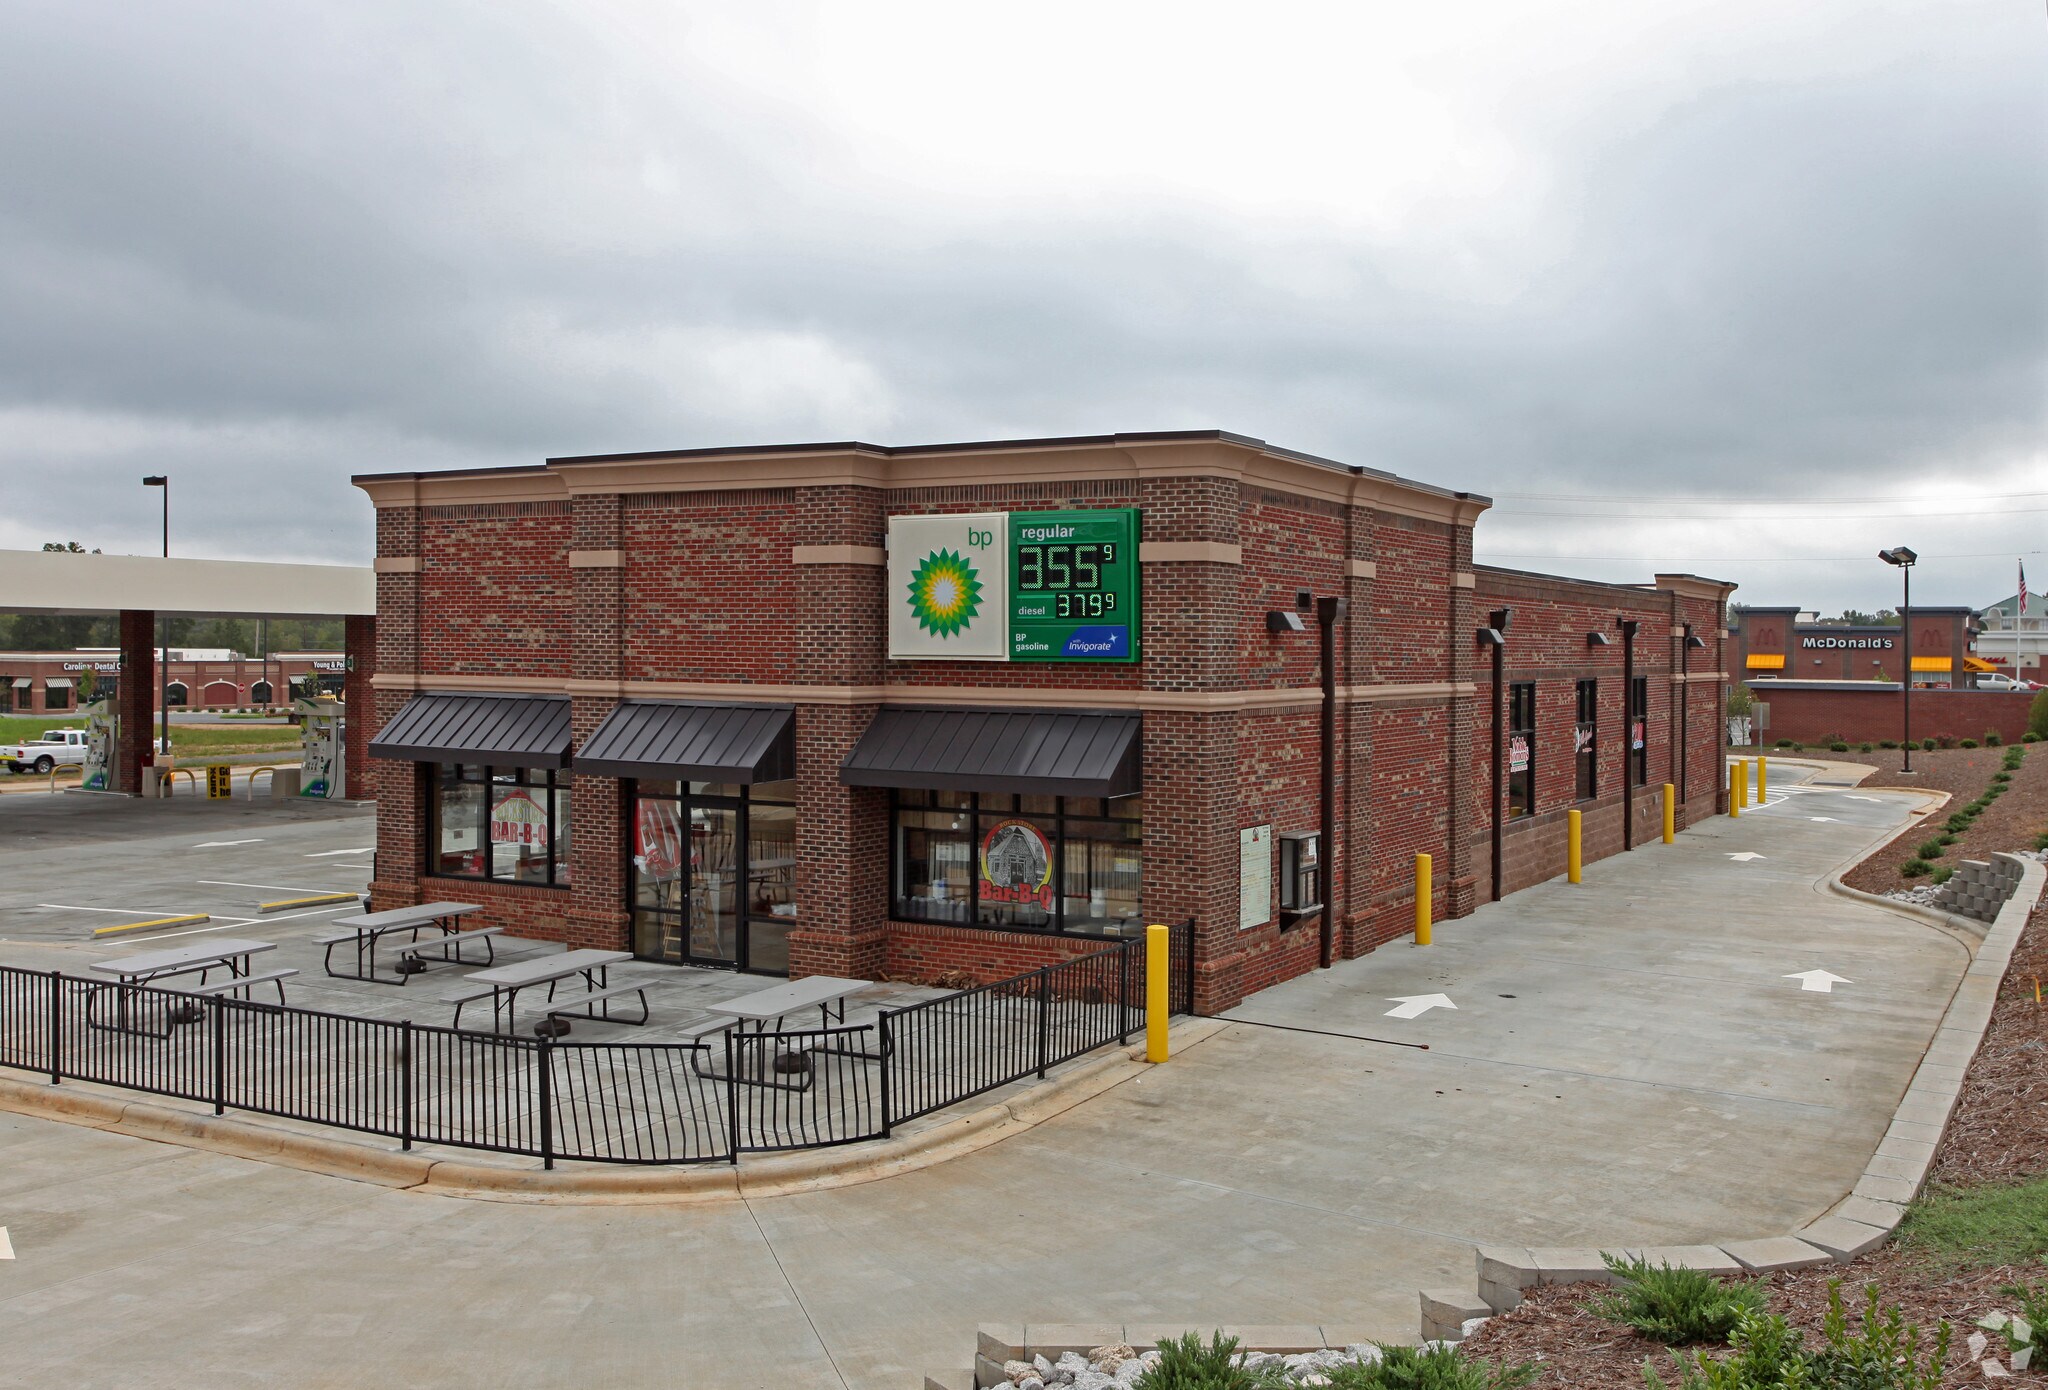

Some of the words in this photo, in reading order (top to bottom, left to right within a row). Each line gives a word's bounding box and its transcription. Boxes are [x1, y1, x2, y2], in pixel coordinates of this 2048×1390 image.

[968, 526, 993, 551] bp
[1021, 523, 1075, 542] regular
[1020, 545, 1098, 589] 355
[1103, 544, 1113, 561] 9
[1018, 606, 1046, 615] diesel
[1058, 593, 1102, 616] 379
[1015, 633, 1027, 642] BP
[1802, 637, 1893, 649] McDonald's
[1015, 641, 1050, 652] gasoline
[1068, 641, 1112, 653] Invigorate
[94, 662, 116, 670] Dental
[313, 661, 331, 670] Young
[491, 820, 547, 848] BAR-B-Q
[979, 879, 1053, 911] Bar-B-Q
